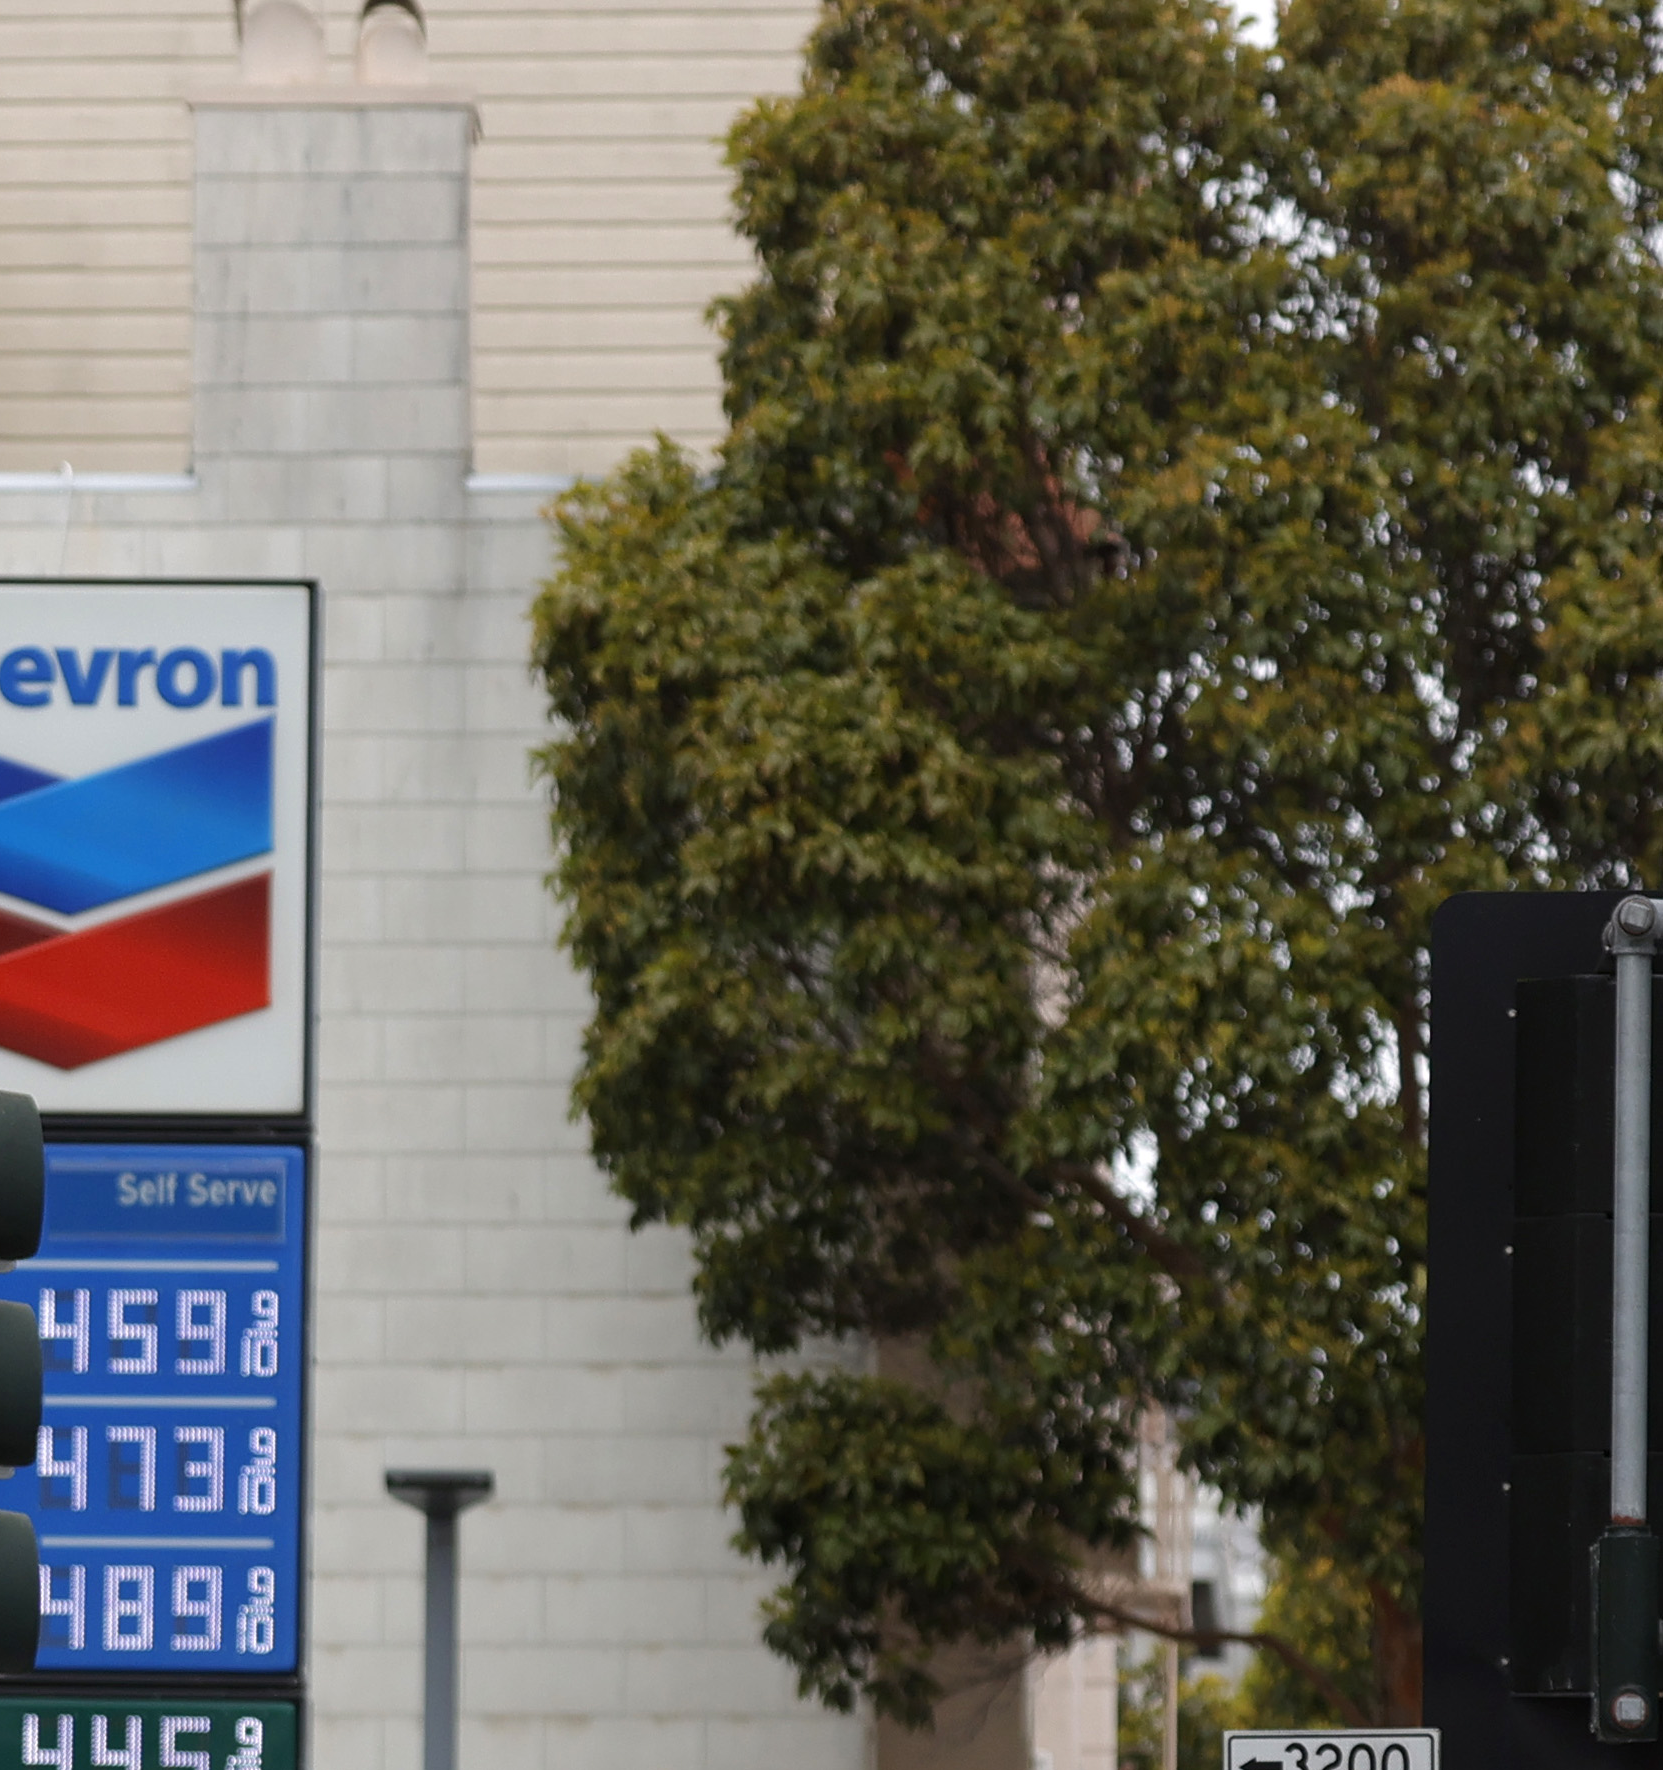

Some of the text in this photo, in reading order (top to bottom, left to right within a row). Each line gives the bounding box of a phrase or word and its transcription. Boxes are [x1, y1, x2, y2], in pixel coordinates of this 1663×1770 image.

[118, 1172, 277, 1206] Self Serve
[37, 1288, 228, 1375] 459
[36, 1425, 226, 1513] 473
[37, 1563, 224, 1652] 489
